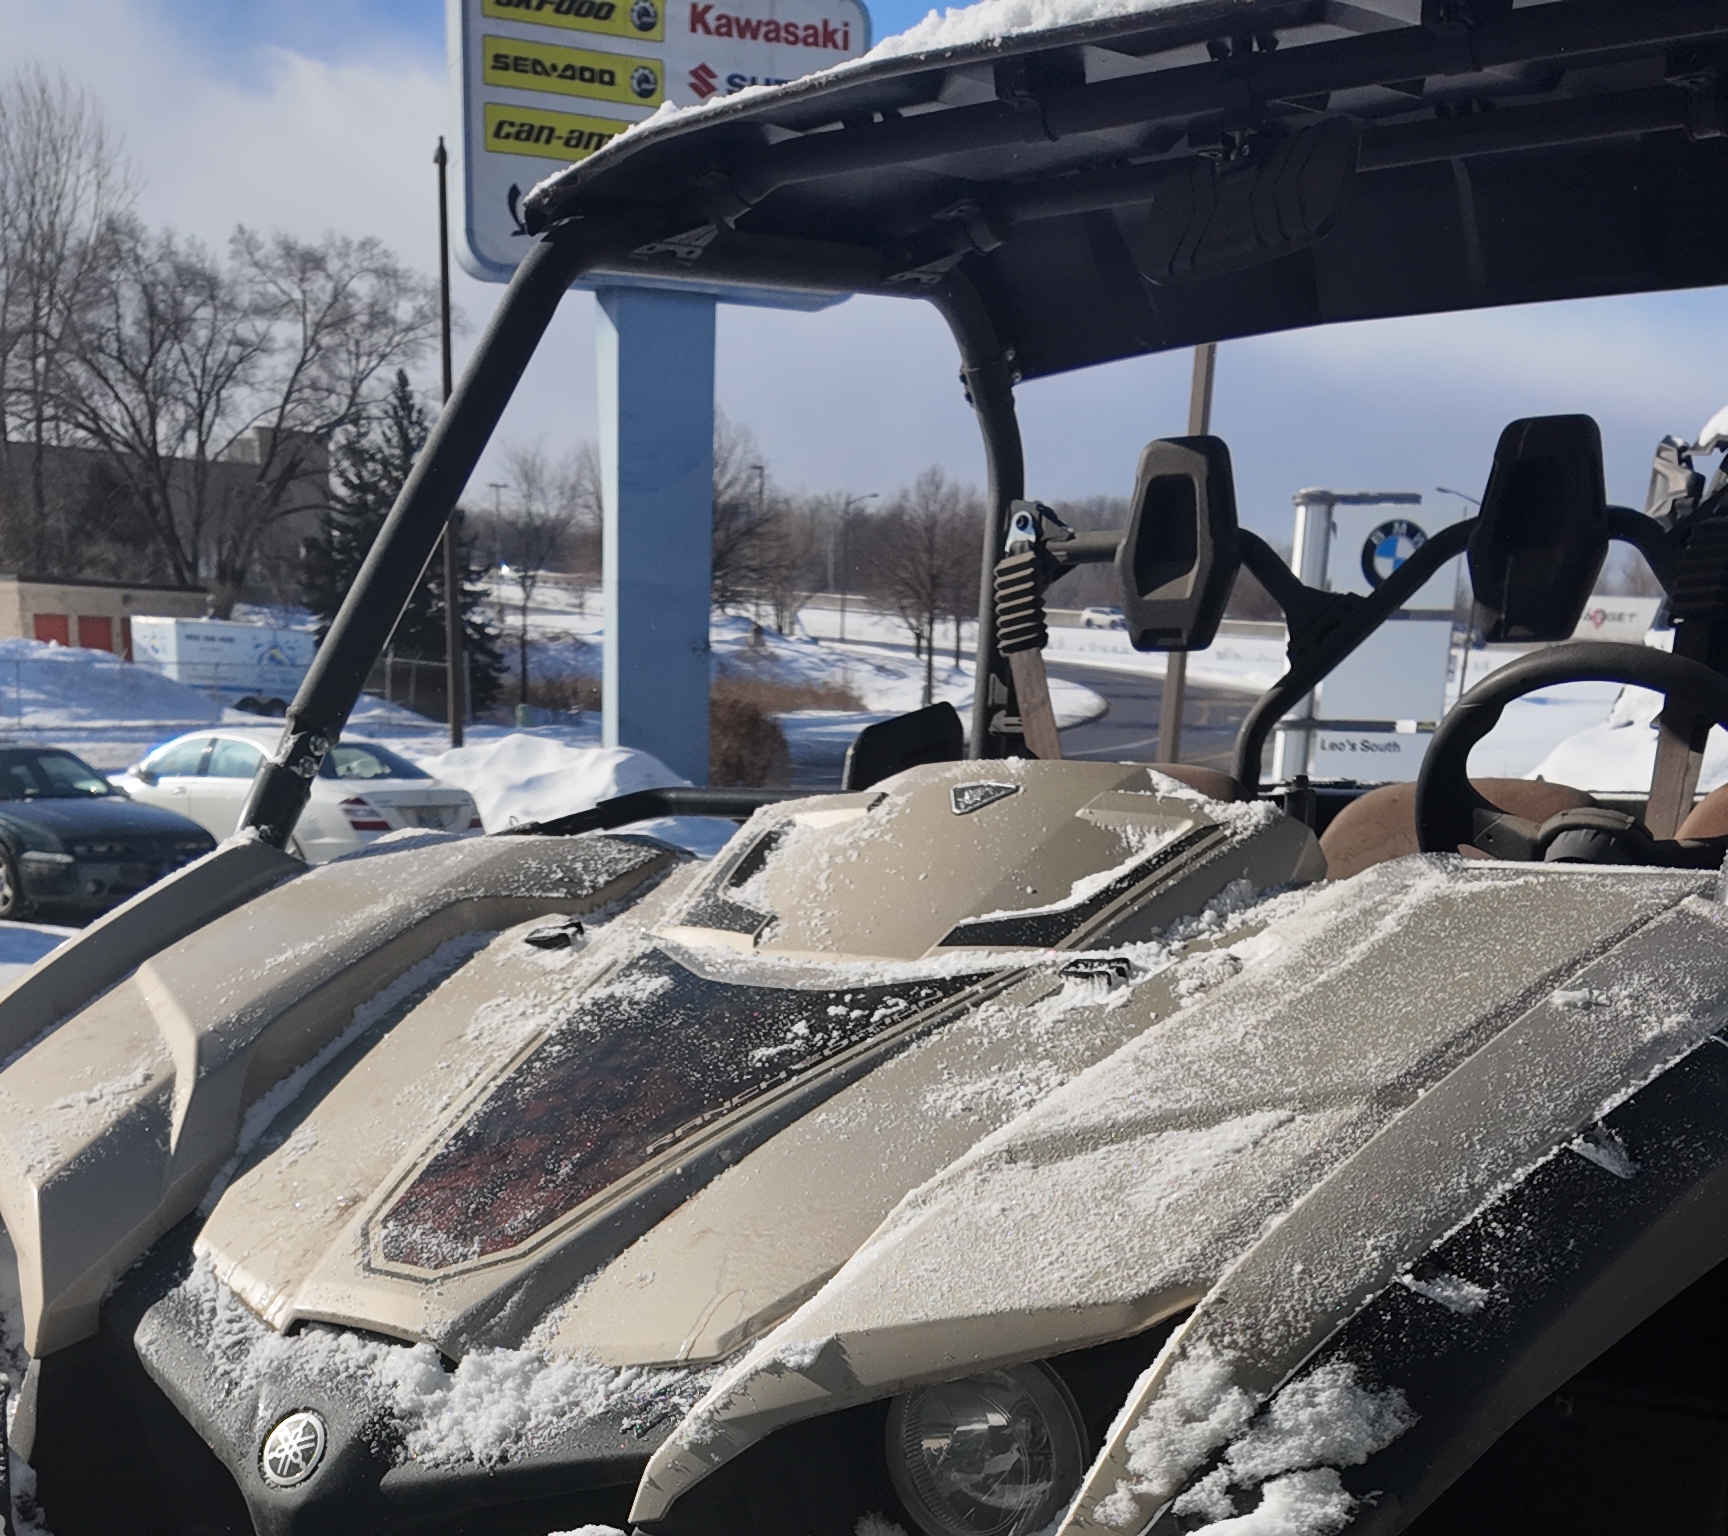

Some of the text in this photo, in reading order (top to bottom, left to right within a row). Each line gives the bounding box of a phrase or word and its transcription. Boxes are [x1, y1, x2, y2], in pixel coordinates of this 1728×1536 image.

[689, 2, 849, 51] Kawasaki
[1320, 738, 1401, 753] Leo's South
